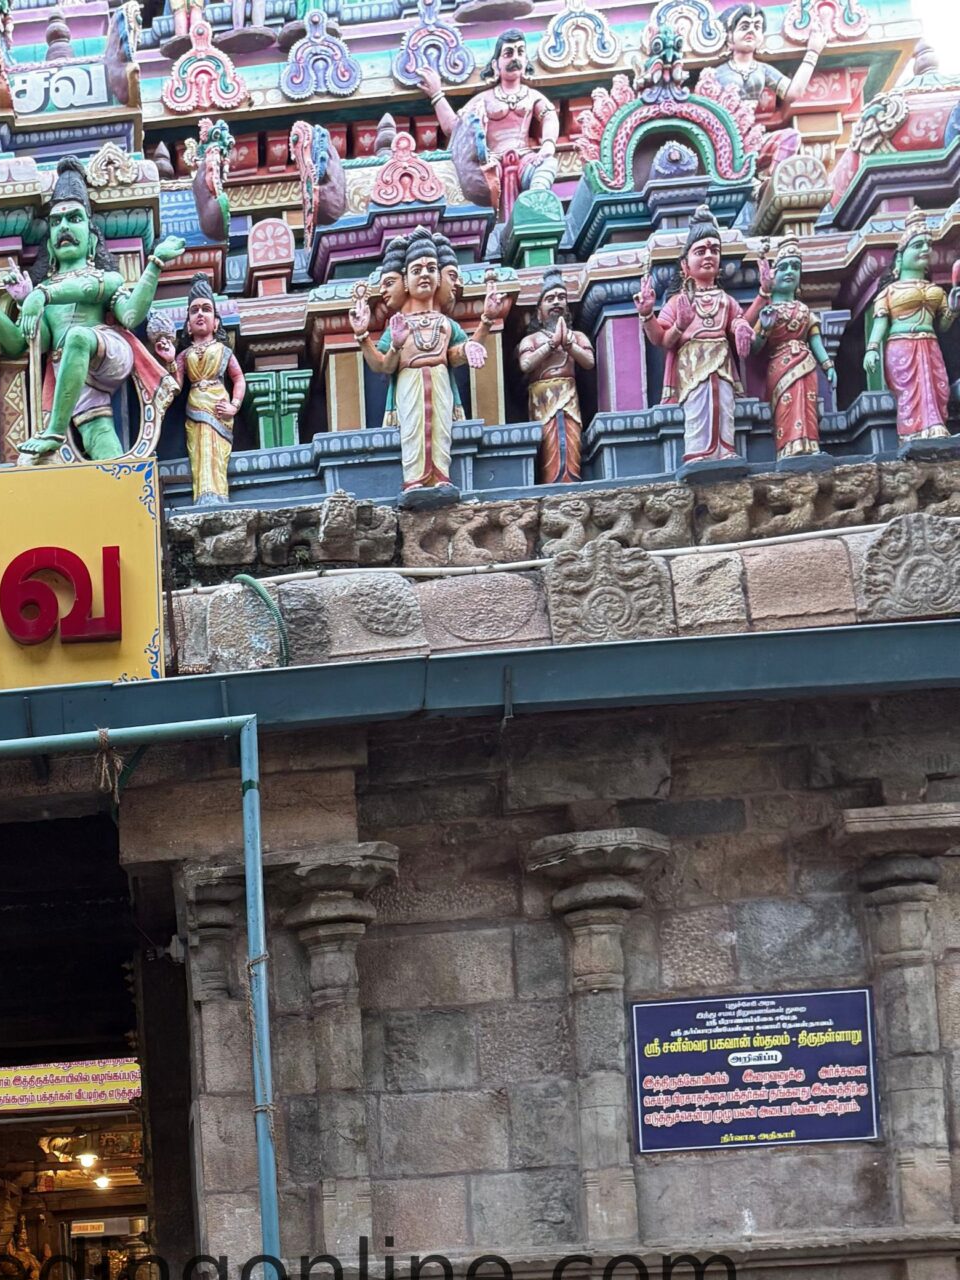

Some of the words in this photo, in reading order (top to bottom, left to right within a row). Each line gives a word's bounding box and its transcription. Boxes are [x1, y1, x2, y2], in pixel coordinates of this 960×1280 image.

[709, 1034, 751, 1050] பகவான்
[753, 1031, 791, 1051] ஸ்தலம்
[797, 1028, 862, 1049] திருநள்ளாறு
[730, 1052, 779, 1065] அறிவிப்பு
[36, 1089, 73, 1104] பக்தர்கள்
[727, 1087, 769, 1105] பக்தர்கள்
